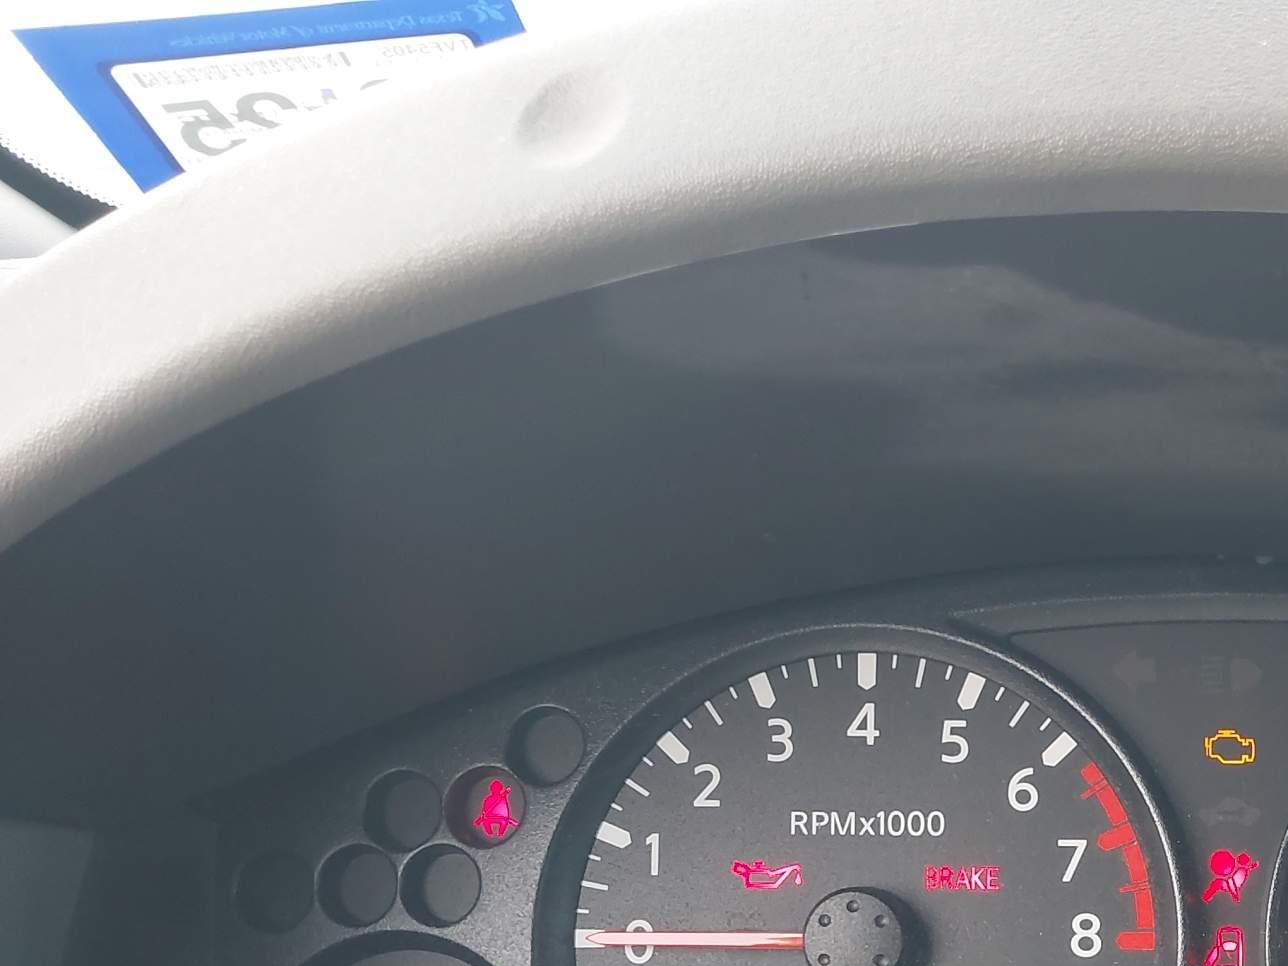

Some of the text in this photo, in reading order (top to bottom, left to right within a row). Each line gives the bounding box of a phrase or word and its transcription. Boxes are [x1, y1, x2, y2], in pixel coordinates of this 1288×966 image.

[767, 718, 793, 762] 3
[847, 703, 879, 745] 4
[942, 720, 968, 763] 5
[693, 764, 720, 807] 2
[1008, 768, 1038, 811] 6
[791, 811, 944, 836] RPMx1000
[646, 833, 660, 875] 1
[1058, 840, 1087, 882] 7
[925, 866, 999, 891] BRAKE
[624, 920, 654, 964] 0
[1070, 914, 1102, 958] 8
